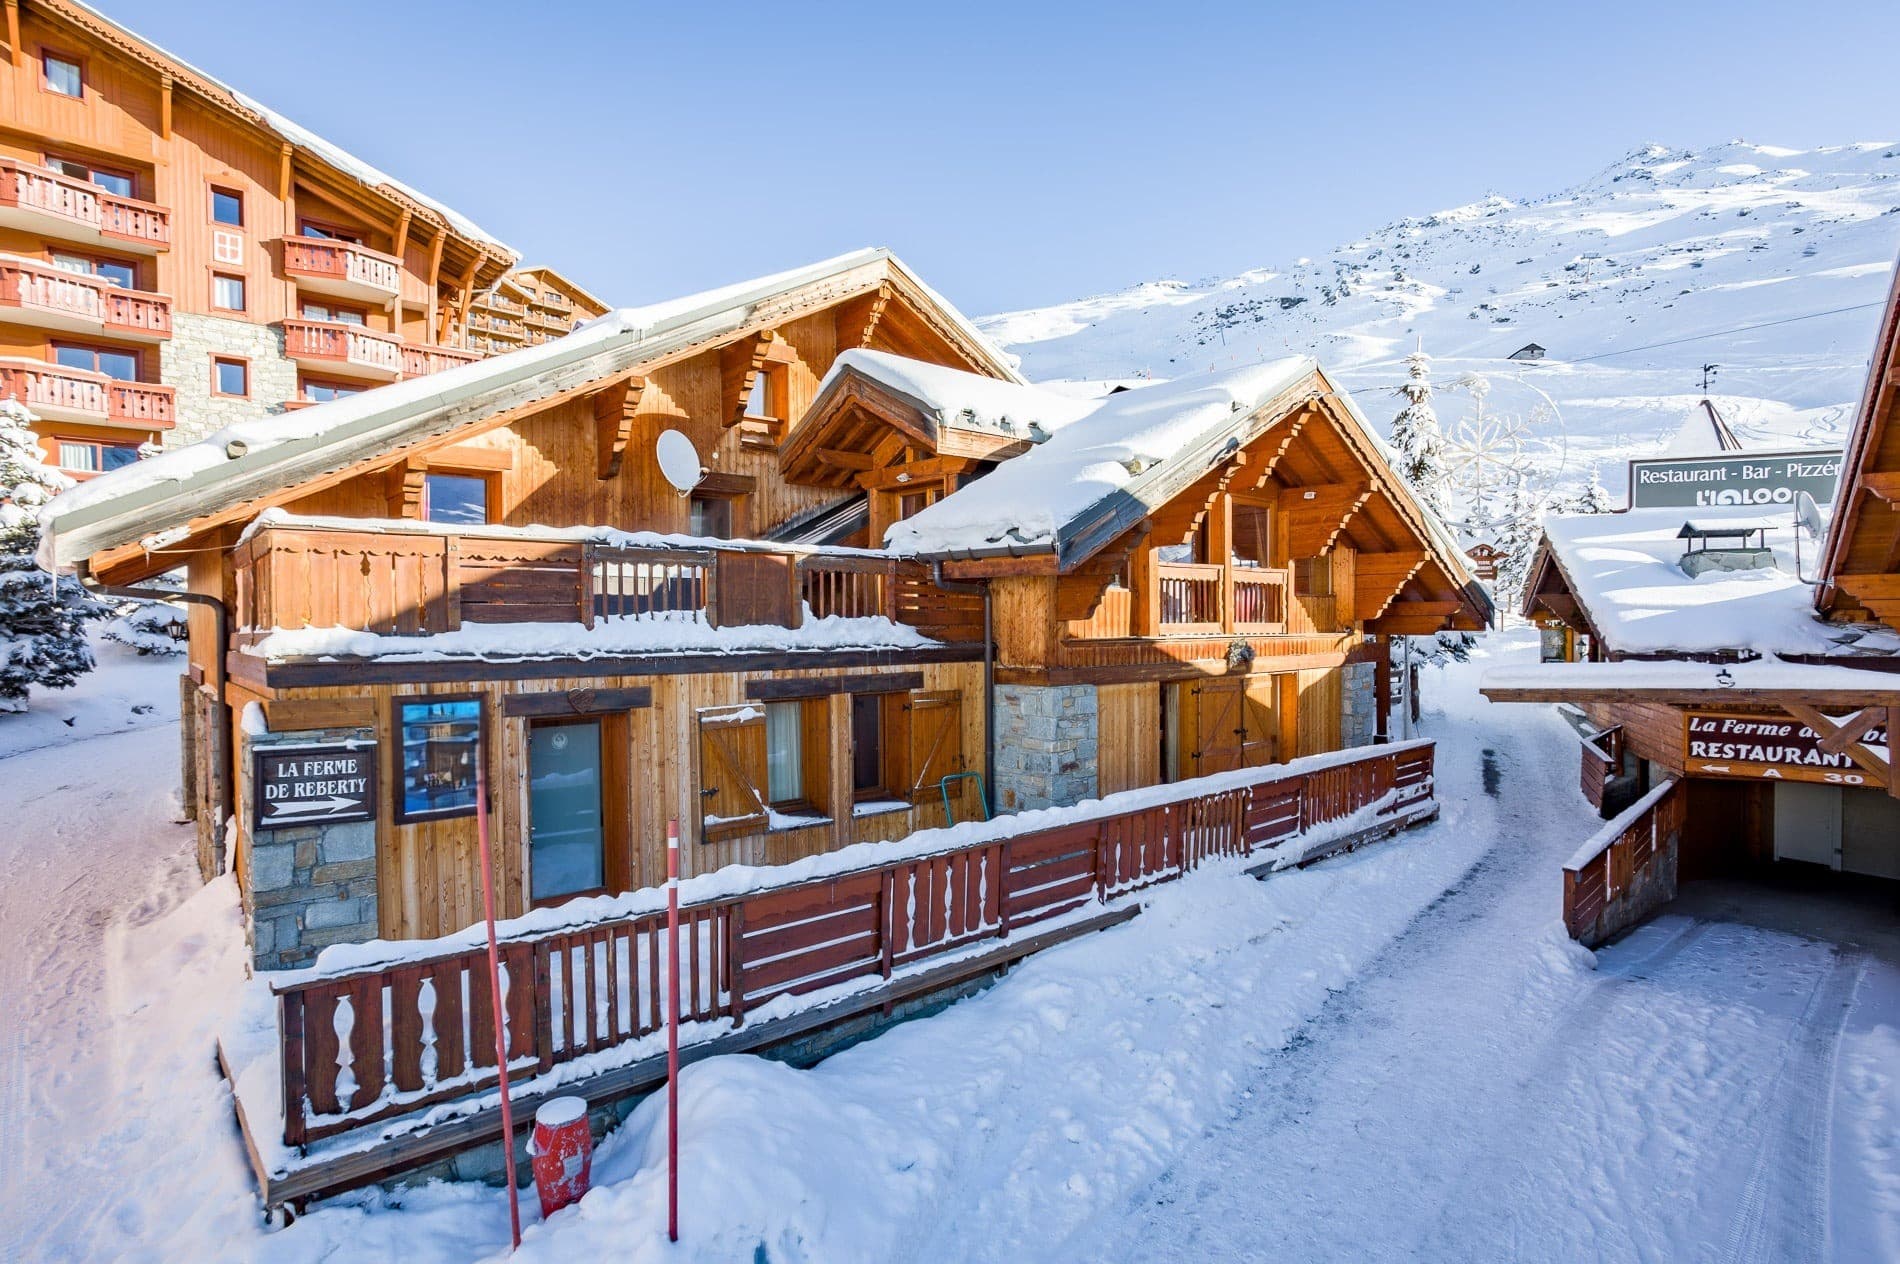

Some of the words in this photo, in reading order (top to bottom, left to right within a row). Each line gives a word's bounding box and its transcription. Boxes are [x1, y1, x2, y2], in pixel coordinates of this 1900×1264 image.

[1640, 466, 1727, 484] Restaurant
[1742, 465, 1771, 480] Bar
[1690, 717, 1716, 732] La
[1722, 719, 1792, 736] Ferme
[1690, 740, 1853, 768] RESTAURANT
[278, 762, 299, 778] LA
[304, 759, 358, 776] FERME
[1762, 768, 1782, 778] A
[1824, 773, 1864, 784] 30
[265, 783, 290, 799] DE
[294, 778, 367, 798] REBERTY
